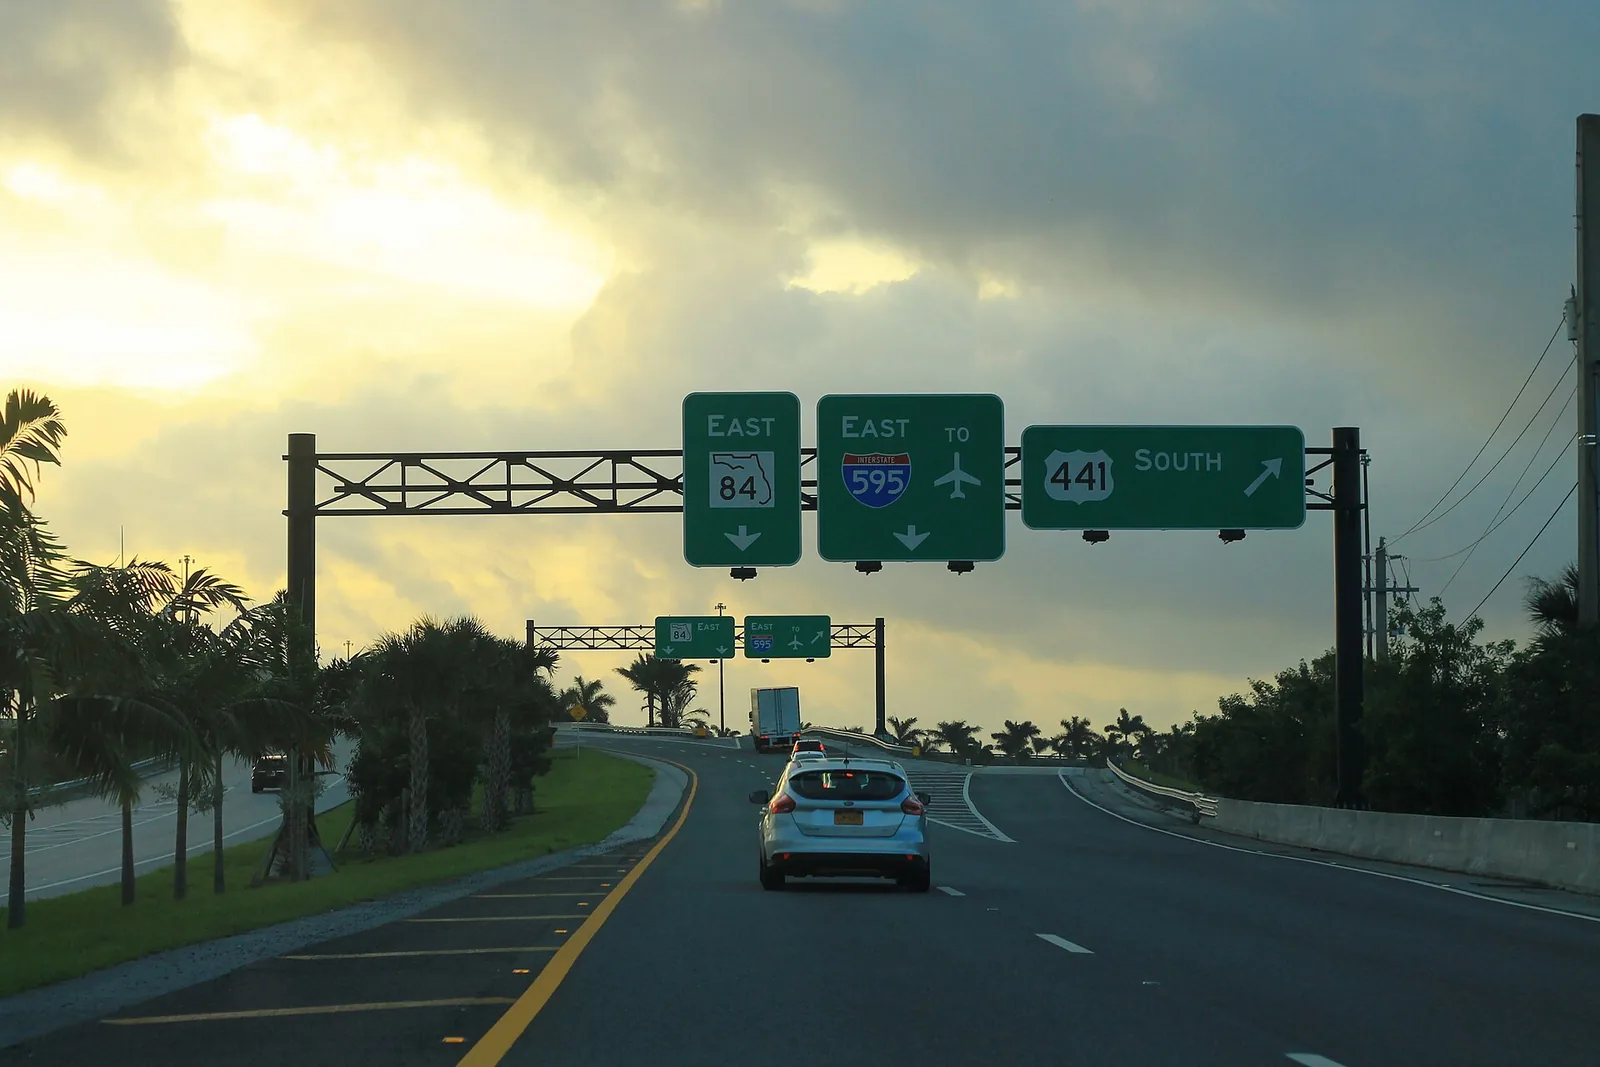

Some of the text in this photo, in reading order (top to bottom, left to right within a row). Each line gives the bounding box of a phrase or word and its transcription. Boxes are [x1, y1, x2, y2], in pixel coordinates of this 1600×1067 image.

[708, 414, 775, 437] EAST
[842, 415, 910, 438] EAST
[945, 427, 970, 442] TO
[857, 456, 895, 464] INTERSTATE
[1135, 448, 1222, 472] SOUTH
[852, 469, 904, 495] 595
[1050, 461, 1106, 491] 441
[719, 475, 757, 501] 84
[673, 630, 686, 640] 84
[697, 622, 720, 631] EAST
[751, 622, 773, 631] EAST
[753, 639, 771, 649] 595
